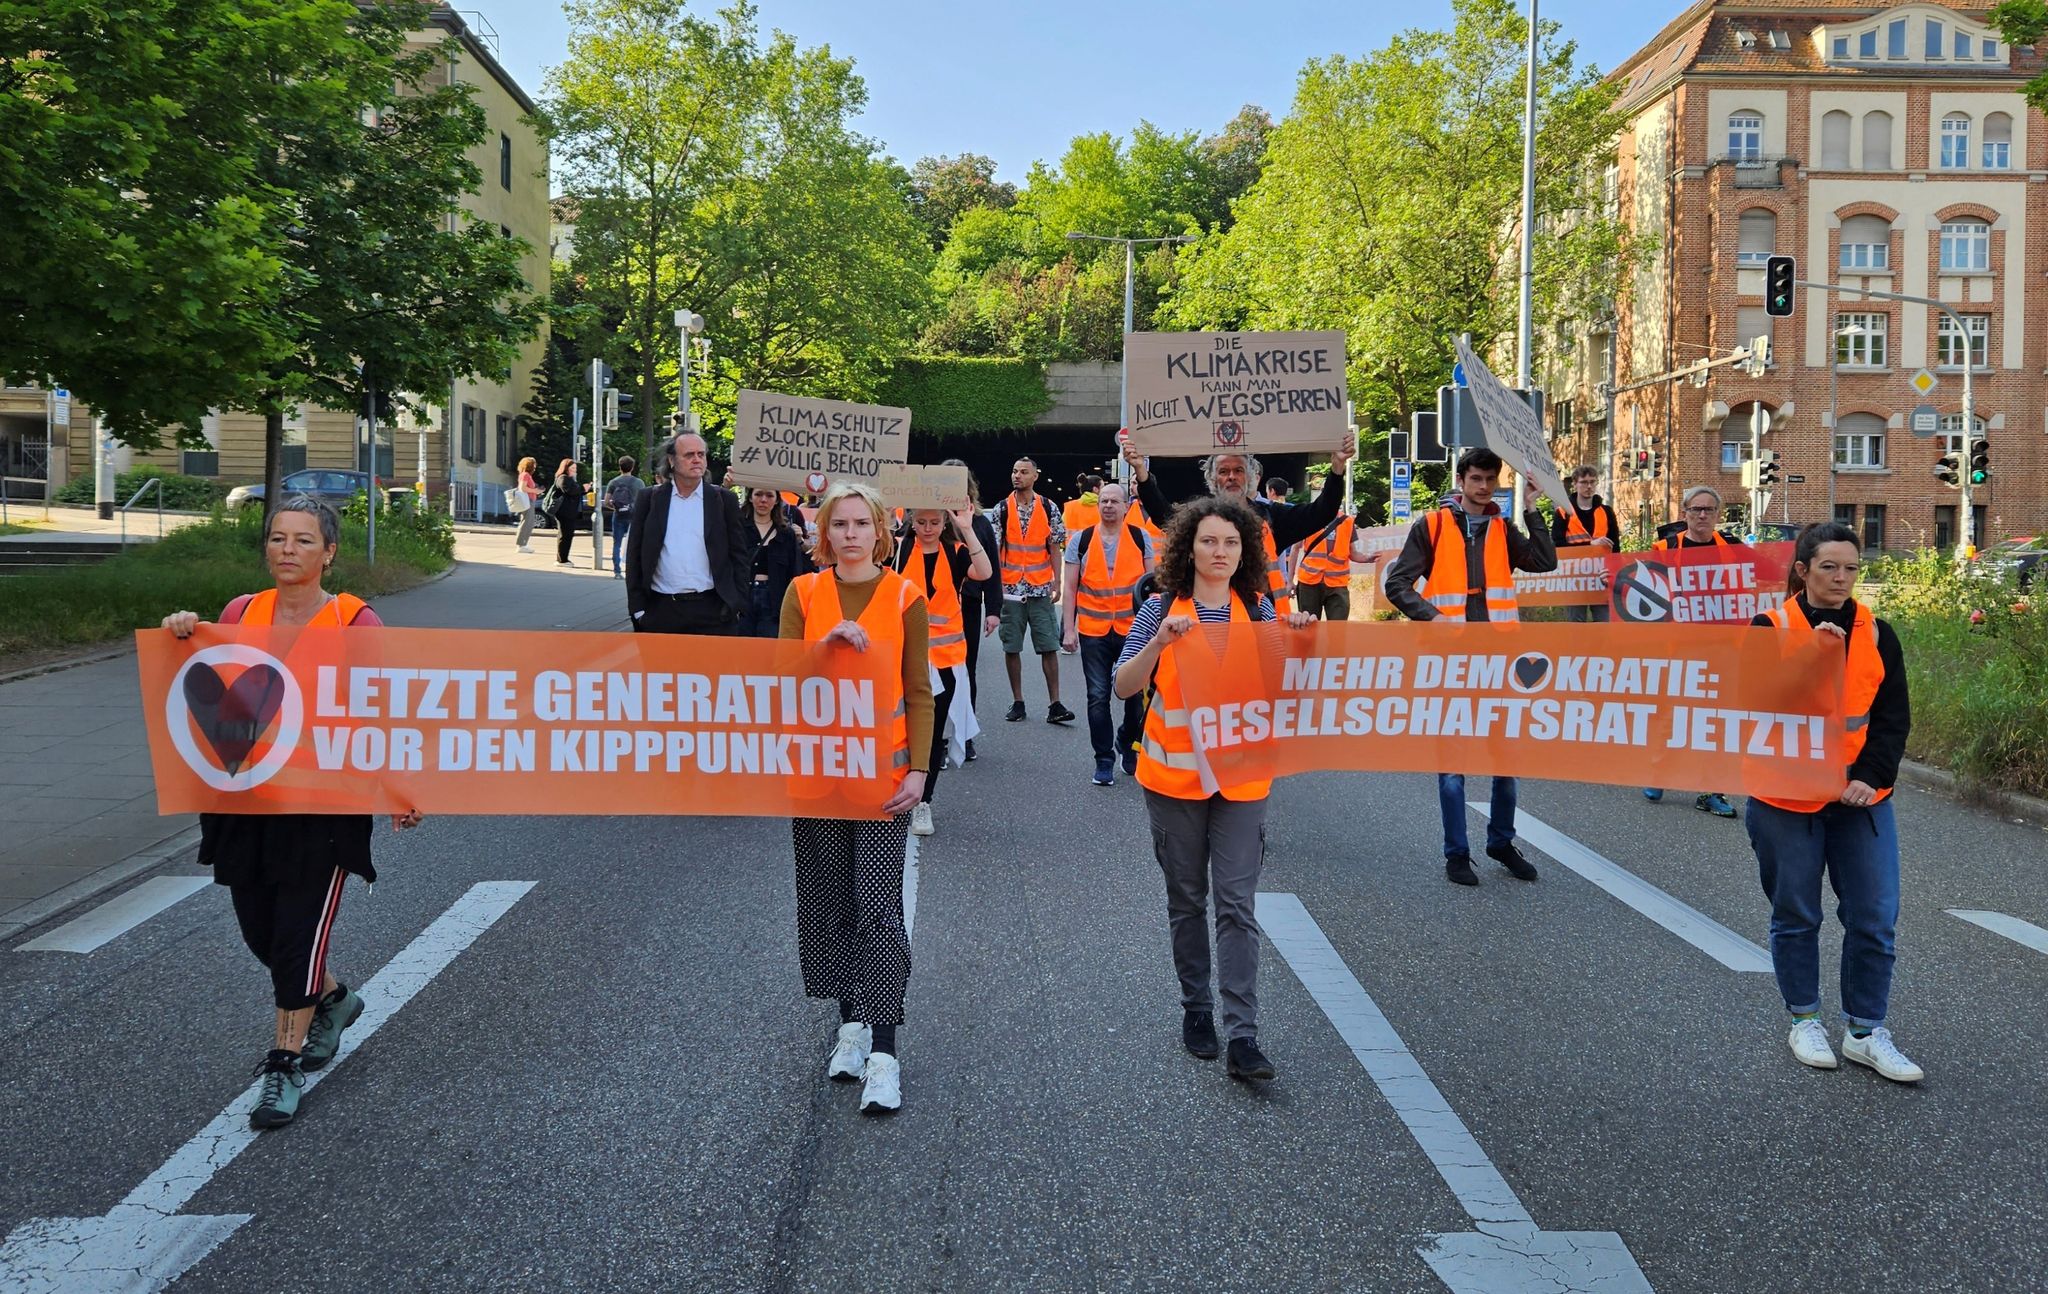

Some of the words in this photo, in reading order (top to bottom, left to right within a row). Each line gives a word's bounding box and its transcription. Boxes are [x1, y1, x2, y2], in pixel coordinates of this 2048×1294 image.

[1214, 337, 1243, 350] DIE
[1167, 350, 1331, 379] KLIMAKRISE
[1202, 381, 1241, 393] KANN
[1247, 379, 1281, 391] MAN
[760, 403, 903, 436] KLIMASCHUTZ
[1136, 398, 1179, 424] NICHT
[1184, 386, 1342, 419] WEGSPERREN
[756, 427, 876, 453] BLOCKIEREN
[826, 454, 905, 477] BEKLO
[1515, 576, 1606, 594] PPPUNKTEN
[1668, 563, 1757, 592] LETZTE
[1281, 656, 1405, 691] MEHR
[315, 665, 517, 721] LETZTE
[533, 669, 876, 729] GENERATION
[1190, 696, 1649, 752] GESELLSCHAFTSRAT
[1666, 706, 1825, 760] JETZT!
[312, 726, 423, 772] VOR
[439, 728, 536, 773] DEN
[550, 730, 877, 779] KIPPPUNKTEN
